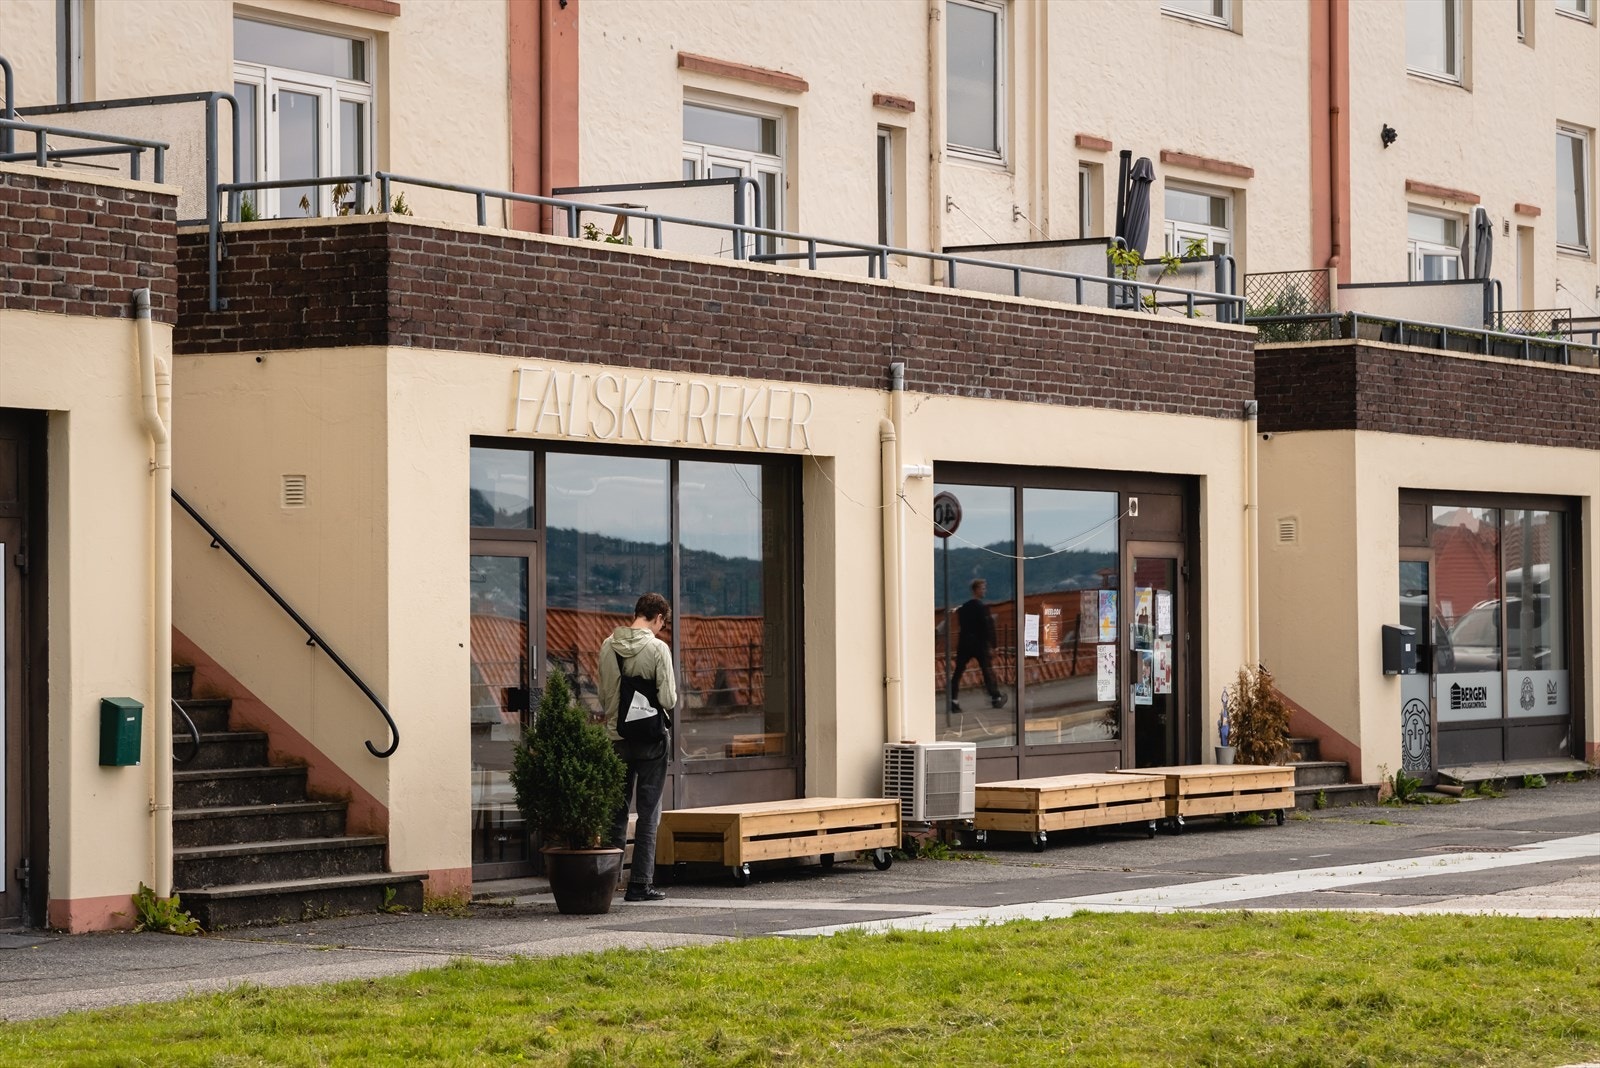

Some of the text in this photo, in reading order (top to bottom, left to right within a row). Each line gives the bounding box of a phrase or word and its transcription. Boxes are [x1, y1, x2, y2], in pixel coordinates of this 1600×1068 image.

[513, 365, 814, 450] FALSKE REKER
[1461, 686, 1487, 701] BERGEN
